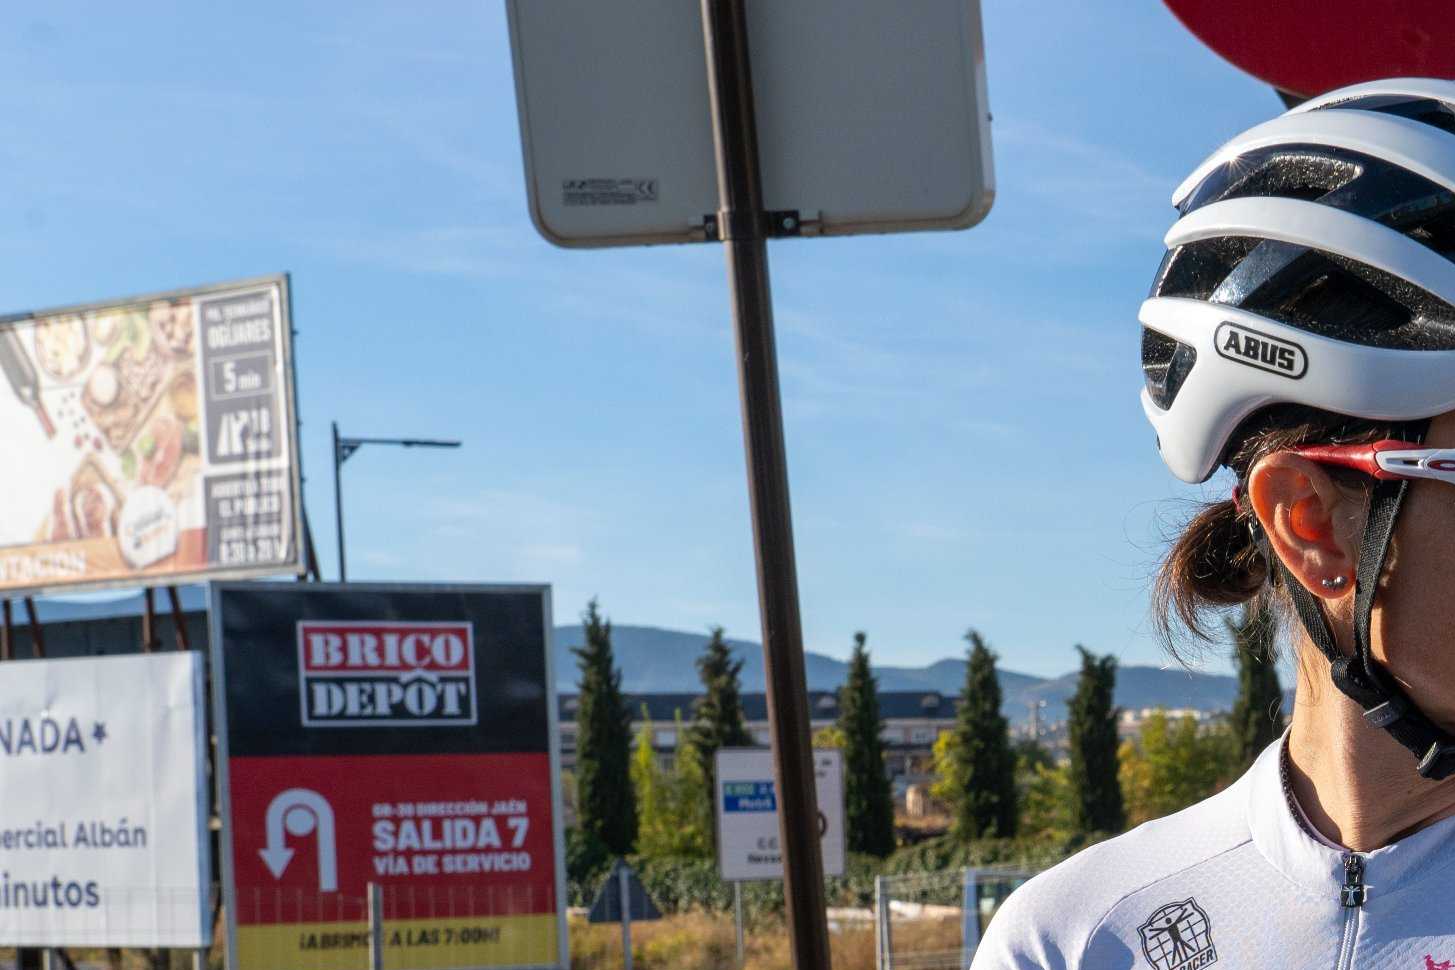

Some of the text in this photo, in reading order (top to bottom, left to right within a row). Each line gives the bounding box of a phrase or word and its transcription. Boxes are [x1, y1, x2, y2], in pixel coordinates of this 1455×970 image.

[1223, 330, 1296, 371] ABUS
[222, 362, 237, 392] 5
[307, 632, 464, 668] BRICO
[0, 817, 147, 849] ercial Albán
[372, 816, 530, 851] SALIDA 7
[412, 854, 440, 875] DE
[441, 851, 532, 874] SERVICIO
[0, 871, 101, 908] inutos
[406, 929, 439, 946] LAS
